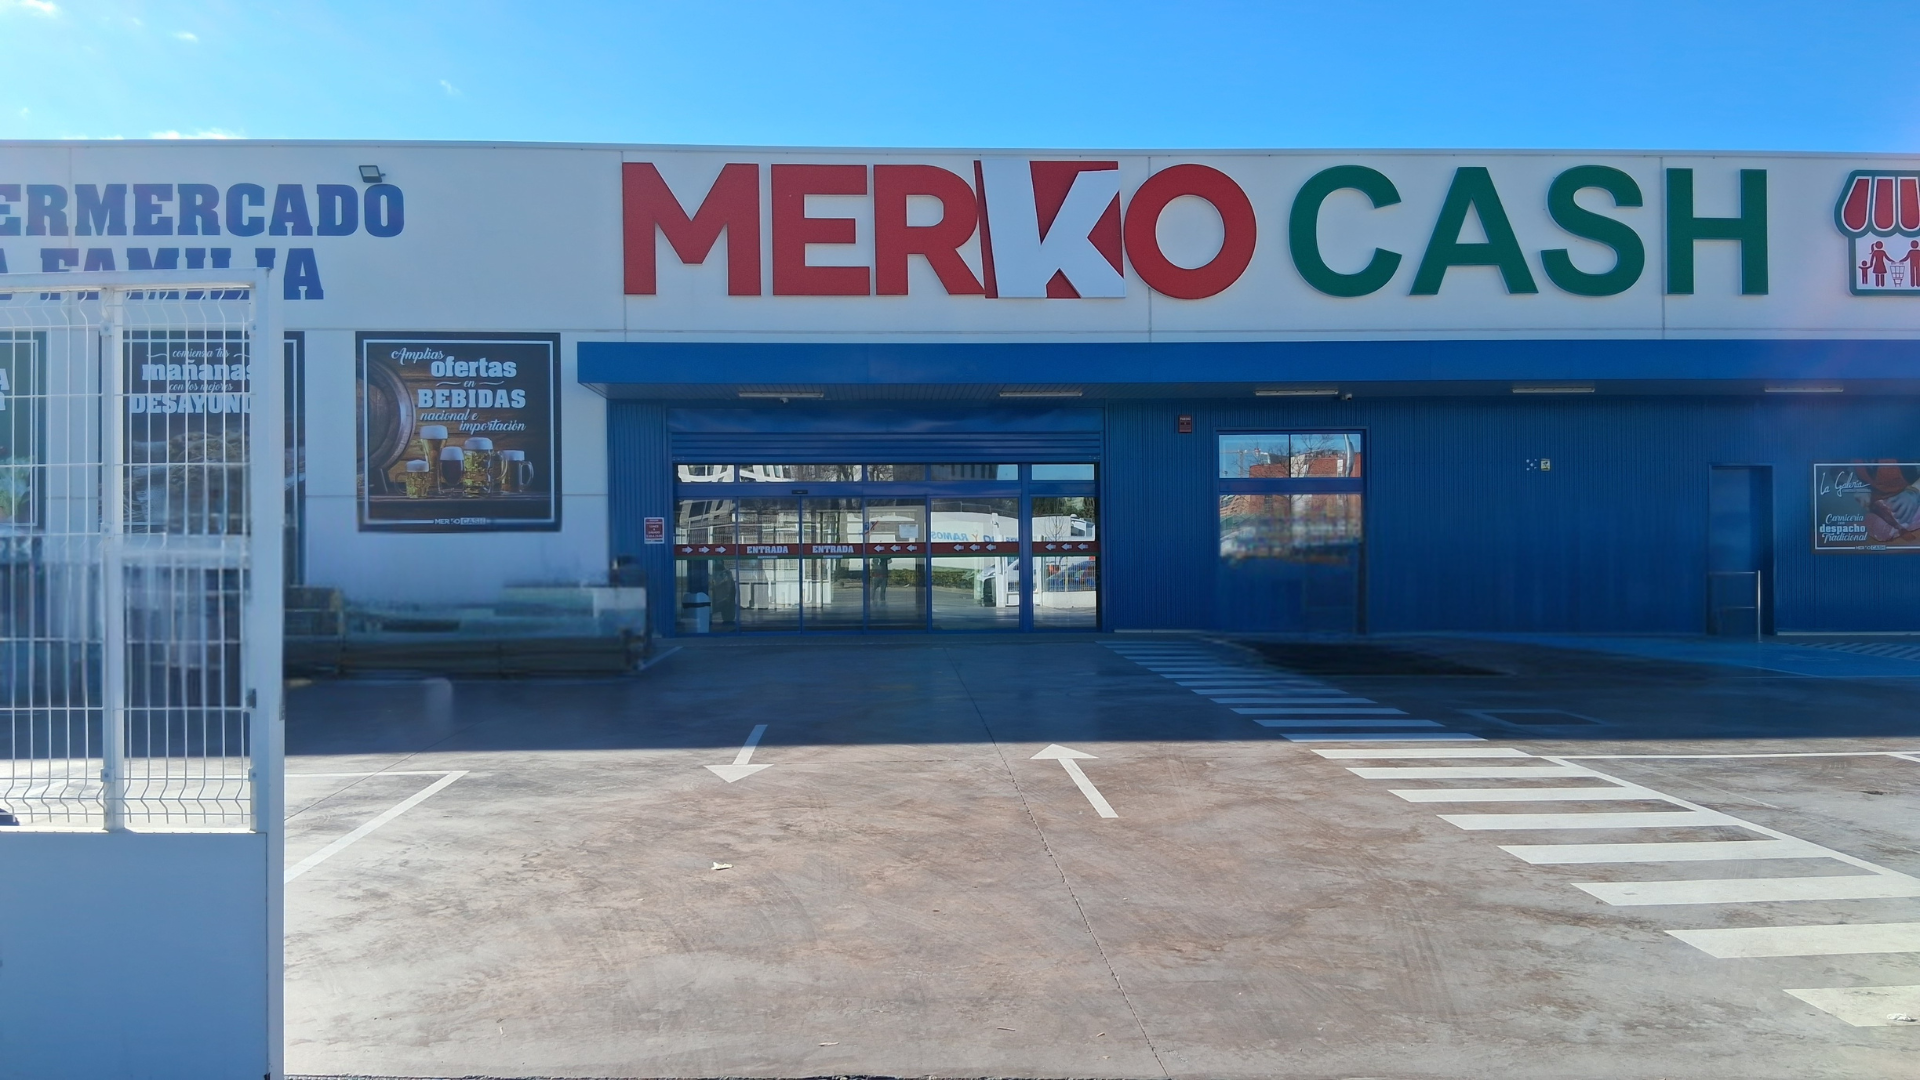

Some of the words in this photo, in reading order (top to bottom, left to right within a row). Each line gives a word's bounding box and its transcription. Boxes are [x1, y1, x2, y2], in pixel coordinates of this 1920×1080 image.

[621, 159, 1257, 299] MERKO
[1289, 164, 1769, 297] CASH
[391, 347, 445, 365] Amplias
[430, 356, 517, 378] ofertas
[463, 380, 476, 388] en
[417, 389, 526, 409] BEBIDAS
[420, 408, 471, 421] nacional
[471, 412, 478, 421] e
[458, 419, 526, 435] importación
[1820, 472, 1831, 496] La
[1819, 524, 1866, 534] despacho
[1821, 532, 1868, 544] Tradicional
[746, 545, 789, 554] ENTRADA
[812, 545, 854, 554] ENTRADA
